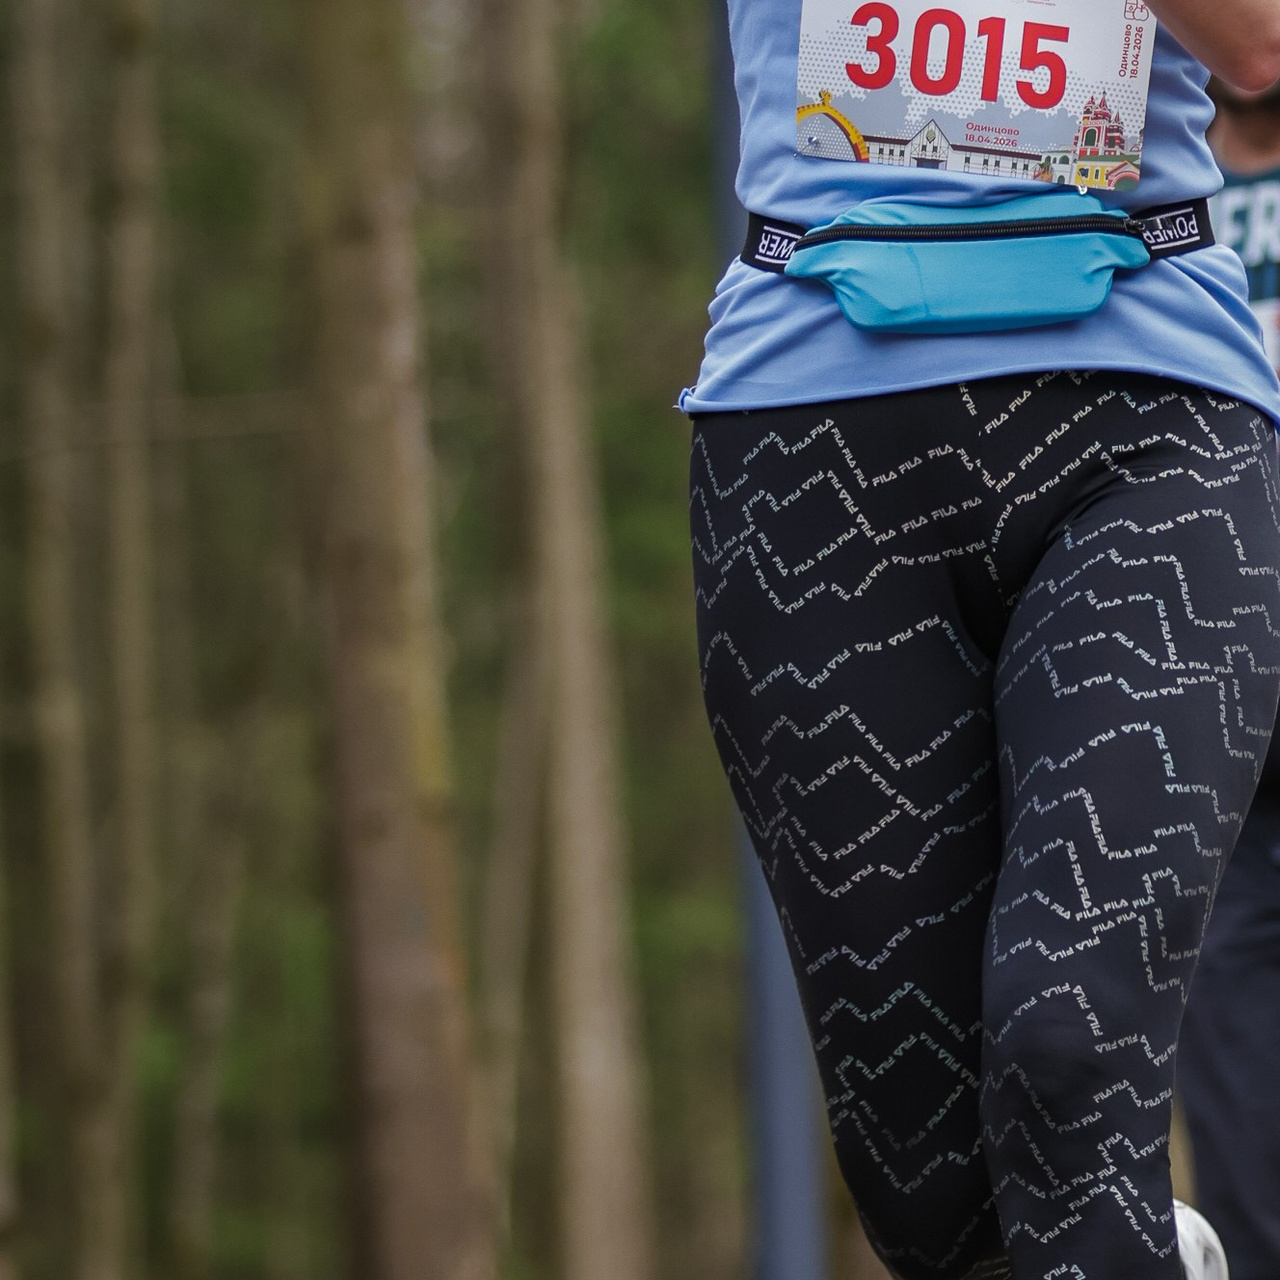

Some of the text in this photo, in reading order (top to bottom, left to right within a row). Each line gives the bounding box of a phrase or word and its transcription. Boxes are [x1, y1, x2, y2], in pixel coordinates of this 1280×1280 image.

[845, 1, 1070, 109] 3015
[1118, 23, 1132, 77] Одинцово
[1129, 26, 1144, 79] 18.04.2026
[966, 121, 1019, 136] Одинцово
[964, 133, 1018, 148] 18.04.2026
[962, 394, 978, 416] FILA
[985, 390, 1032, 434] FILA FILA
[759, 432, 776, 450] FILA
[791, 419, 834, 454] FILA FILA
[996, 390, 1116, 493] FILA FILA FILA FILA FILA
[1138, 434, 1161, 449] FILA
[1194, 414, 1224, 451] FILA FILA
[774, 435, 790, 455] FILA
[1165, 432, 1211, 459] FILA FILA
[842, 448, 868, 489] FILA FILA
[872, 444, 954, 487] FILA FILA FILA
[957, 448, 973, 471] FILA
[1101, 451, 1118, 471] FILA
[1015, 441, 1102, 505] FILA FILA FILA FILA
[1158, 467, 1184, 478] FILA
[1188, 469, 1205, 483] FILA
[781, 470, 825, 507] FILA FILA
[827, 470, 876, 537] FILA FILA FILA
[996, 504, 1013, 528] FILA
[1100, 518, 1124, 532] FILA
[1146, 510, 1199, 534] FILA FILA
[874, 516, 928, 545] FILA FILA
[793, 527, 858, 576] FILA FILA FILA
[1082, 552, 1105, 570] FILA
[1107, 548, 1123, 564] FILA
[1122, 557, 1148, 568] FILA
[772, 556, 788, 577] FILA
[854, 558, 889, 597] FILA FILA
[785, 581, 826, 614] FILA FILA
[831, 583, 851, 601] FILA
[1096, 593, 1153, 610] FILA FILA
[888, 614, 941, 646] FILA FILA
[1079, 632, 1106, 646] FILA
[1160, 620, 1178, 661] FILA FILA
[827, 649, 851, 669] FILA
[1112, 631, 1157, 666] FILA FILA
[787, 662, 807, 685] FILA
[808, 670, 830, 689] FILA
[1082, 673, 1112, 687] FILA
[1132, 690, 1158, 700] FILA
[824, 704, 850, 724] FILA
[848, 712, 902, 771] FILA FILA FILA
[904, 730, 952, 767] FILA FILA
[1059, 721, 1151, 769] FILA FILA FILA
[1153, 726, 1176, 777] FILA FILA
[826, 755, 851, 775] FILA
[853, 755, 921, 817] FILA FILA FILA
[833, 809, 900, 860] FILA FILA FILA
[1095, 835, 1109, 855] FILA
[1108, 843, 1158, 860] FILA FILA
[851, 864, 875, 882] FILA
[880, 864, 905, 880] FILA
[1072, 864, 1092, 908] FILA FILA
[1050, 903, 1071, 919] FILA
[1076, 899, 1129, 921] FILA FILA
[887, 926, 913, 947] FILA
[1092, 920, 1115, 934] FILA
[1048, 936, 1101, 962] FILA FILA
[1014, 982, 1071, 1017] FILA FILA
[1072, 985, 1104, 1036] FILA FILA
[1140, 1034, 1155, 1059] FILA
[1097, 1142, 1114, 1164] FILA
[1123, 1137, 1141, 1160] FILA
[1097, 1164, 1118, 1179] FILA
[1110, 1185, 1128, 1208] FILA
[1120, 1175, 1139, 1197] FILA
[1060, 1213, 1082, 1229] FILA
[1124, 1208, 1142, 1231] FILA
[1141, 1201, 1158, 1223] FILA
[1043, 1263, 1069, 1280] FILA
